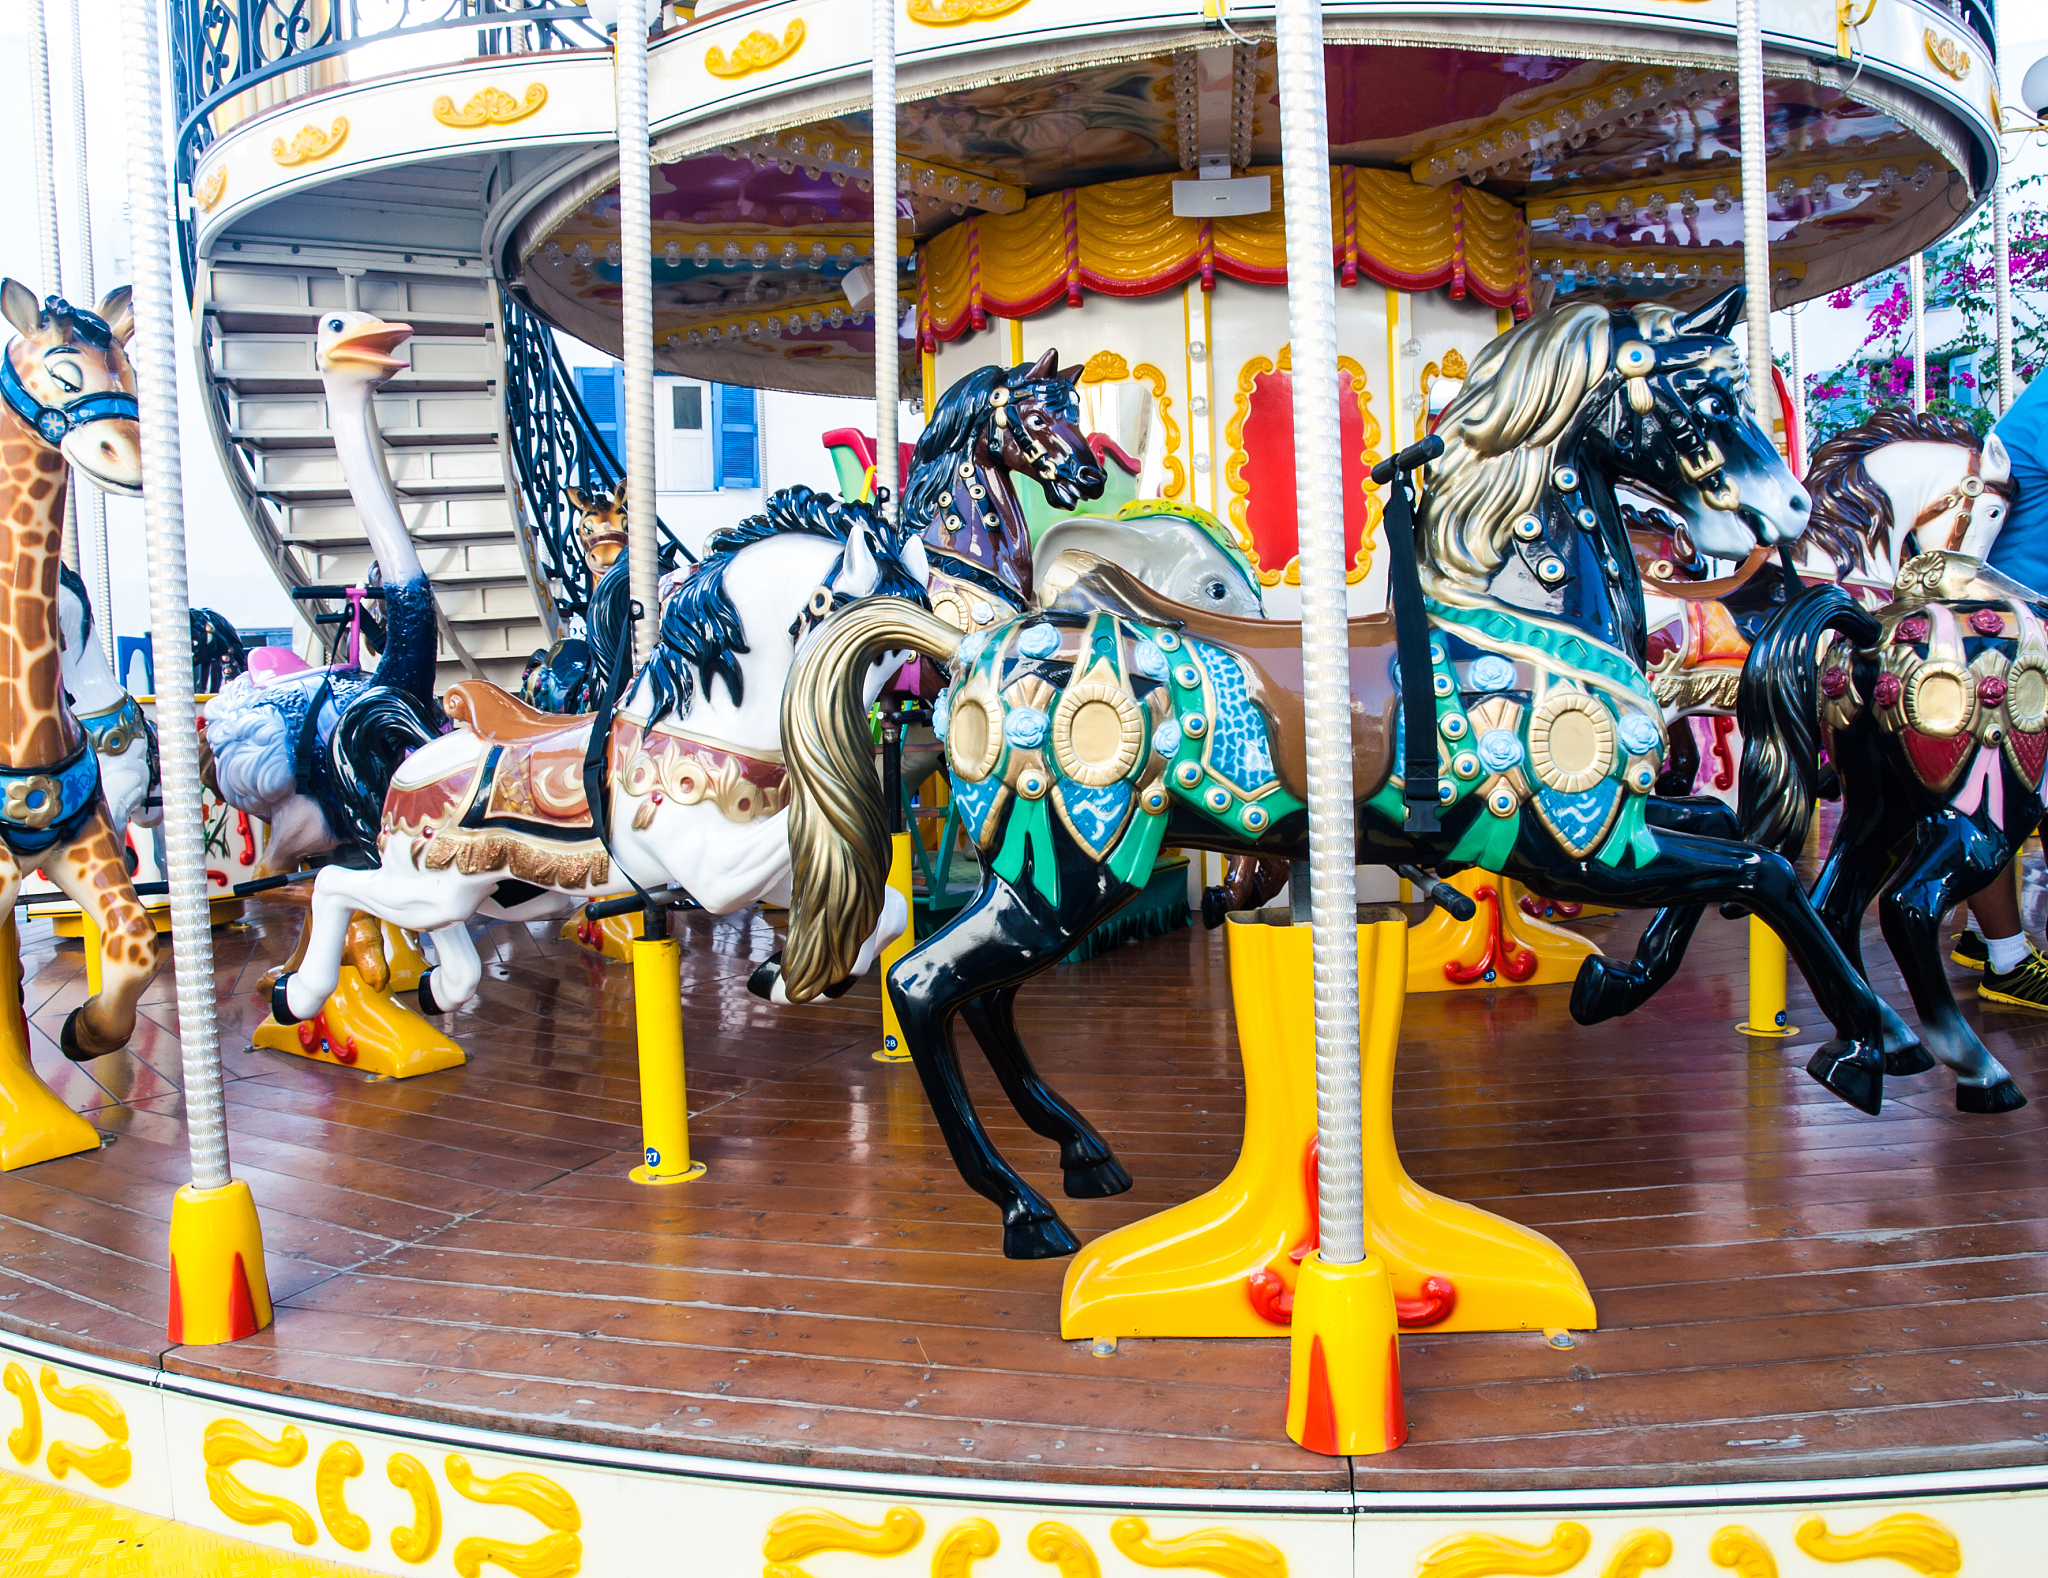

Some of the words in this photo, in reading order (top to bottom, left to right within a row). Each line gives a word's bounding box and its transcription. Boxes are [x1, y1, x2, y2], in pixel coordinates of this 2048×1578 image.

[1484, 972, 1495, 980] 33
[1776, 1015, 1786, 1023] 32
[886, 1039, 896, 1048] 28
[647, 1152, 658, 1163] 27
